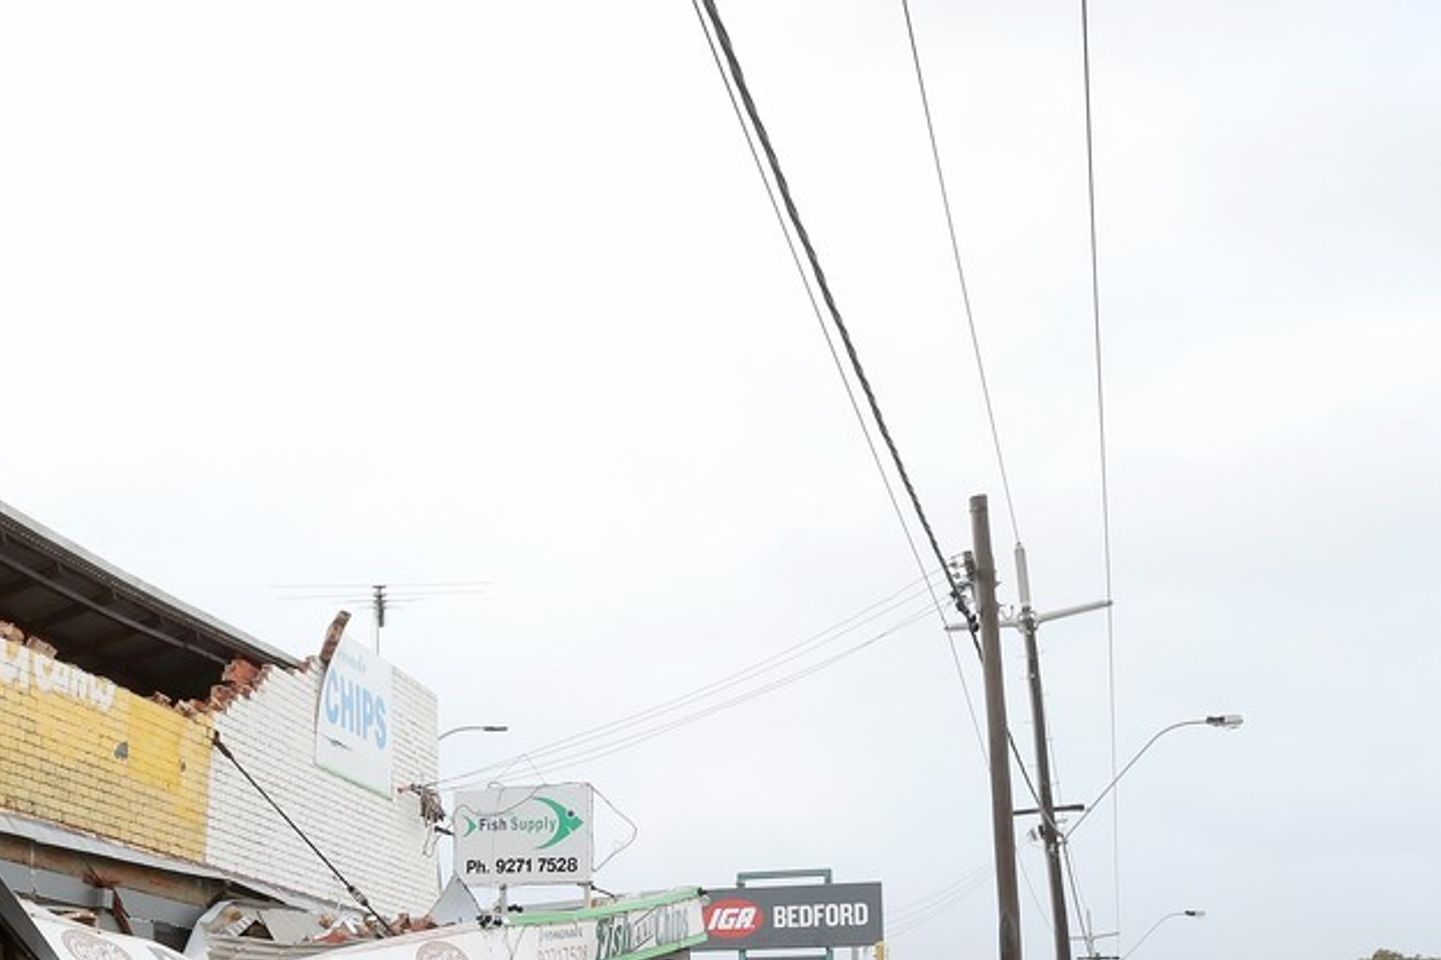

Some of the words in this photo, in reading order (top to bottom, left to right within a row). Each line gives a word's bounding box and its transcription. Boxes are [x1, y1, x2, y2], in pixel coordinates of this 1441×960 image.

[325, 667, 387, 749] CHIPS
[480, 818, 507, 831] Fish
[510, 816, 557, 833] Supply
[466, 859, 491, 874] Ph.
[496, 858, 532, 874] 9271
[538, 857, 578, 873] 7528
[708, 906, 756, 930] IGA
[773, 903, 869, 928] BEDFORD
